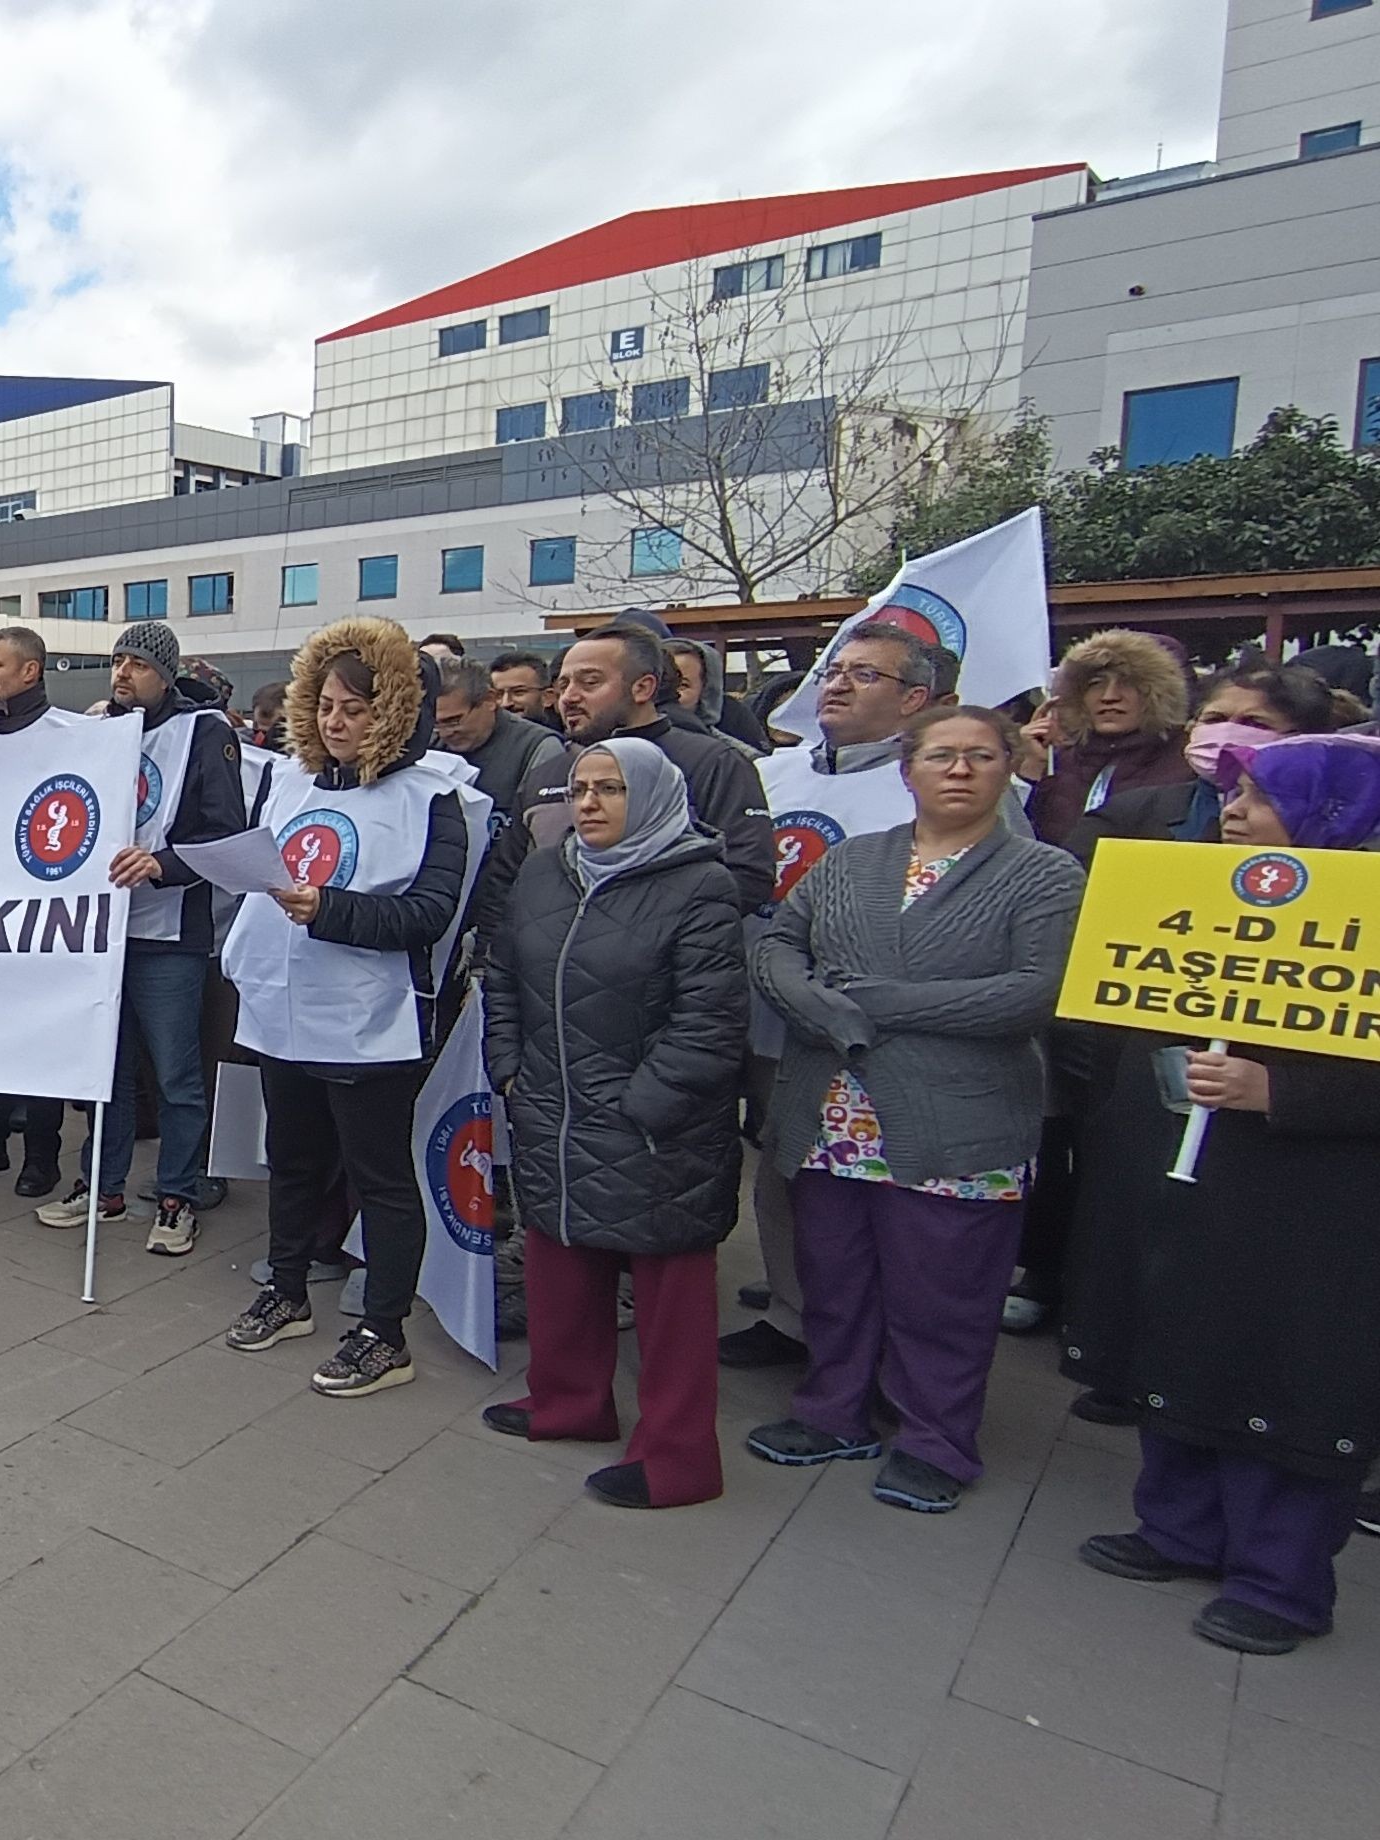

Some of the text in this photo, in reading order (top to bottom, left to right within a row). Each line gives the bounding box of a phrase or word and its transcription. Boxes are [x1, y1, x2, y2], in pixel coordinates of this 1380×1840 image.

[619, 330, 636, 350] E
[612, 349, 641, 360] BLOK
[1158, 910, 1195, 936] 4
[1299, 918, 1361, 951] Lİ
